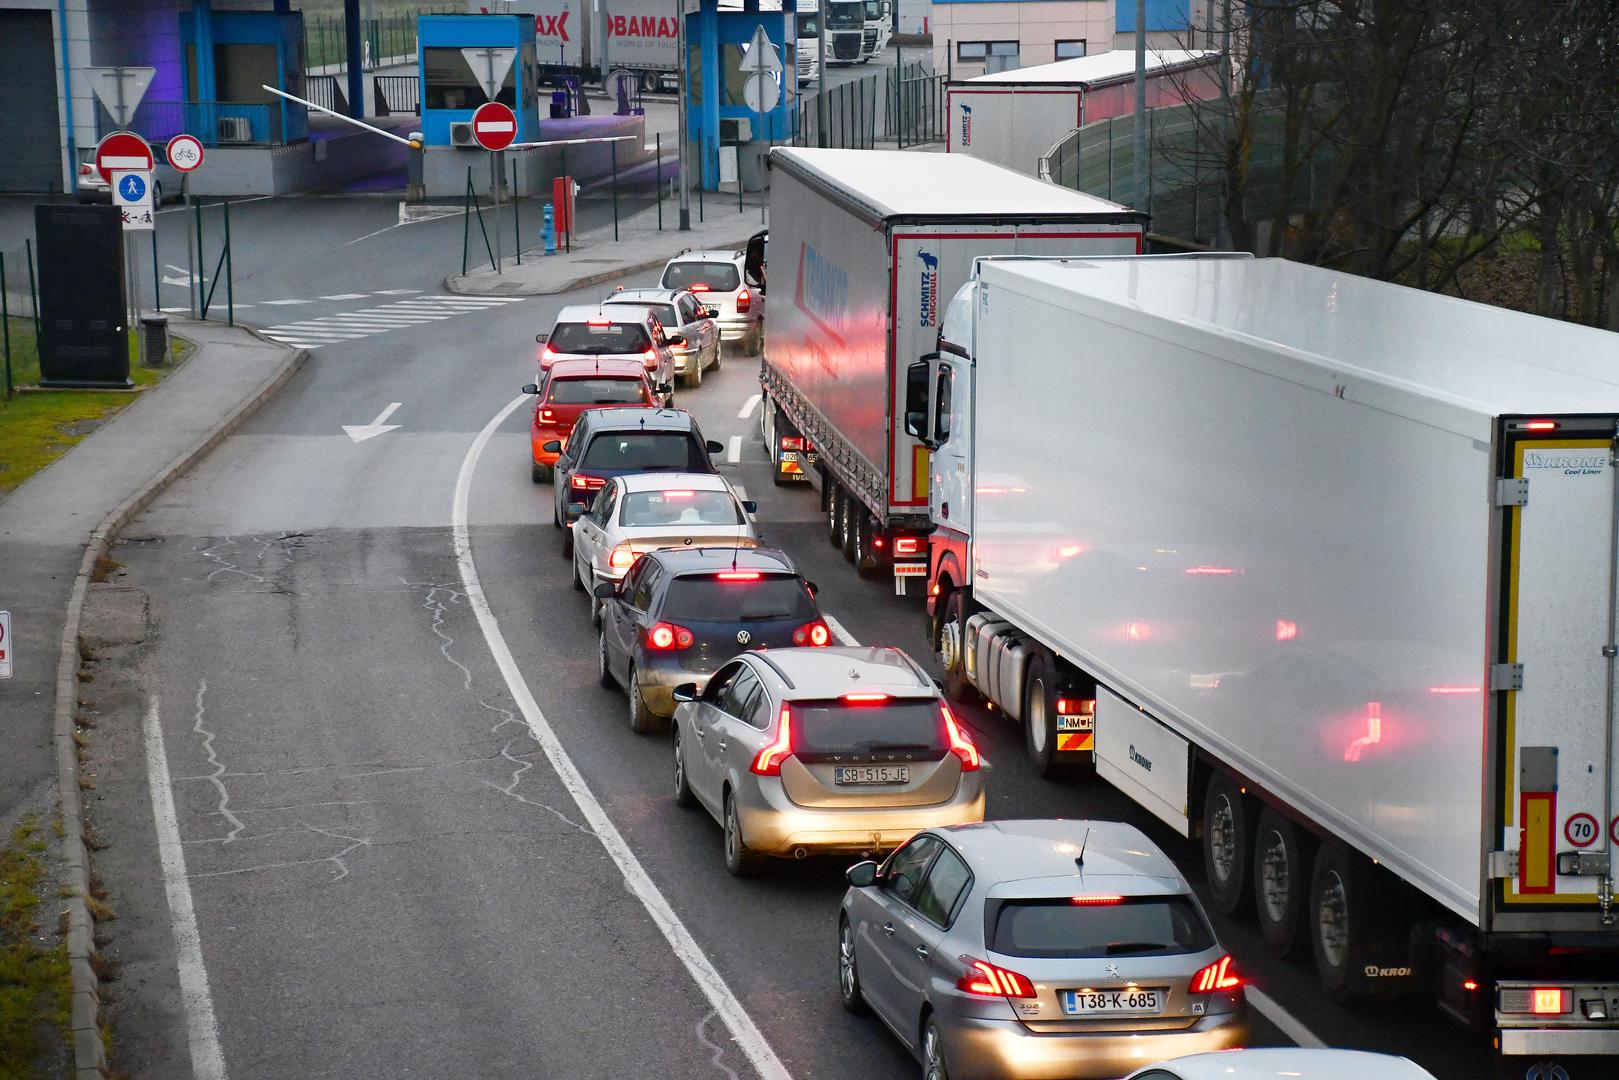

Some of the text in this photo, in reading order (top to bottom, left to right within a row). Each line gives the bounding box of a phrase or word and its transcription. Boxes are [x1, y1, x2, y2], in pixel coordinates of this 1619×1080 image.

[616, 40, 642, 48] WORLD
[644, 40, 655, 48] OF
[920, 272, 929, 327] SCHMITZ
[929, 271, 937, 327] CARGOBULL
[1544, 456, 1605, 469] KRONE
[1065, 718, 1080, 728] NM
[844, 768, 906, 781] SB 515-JE
[1574, 823, 1591, 838] 70
[1077, 993, 1156, 1009] T38-K-685
